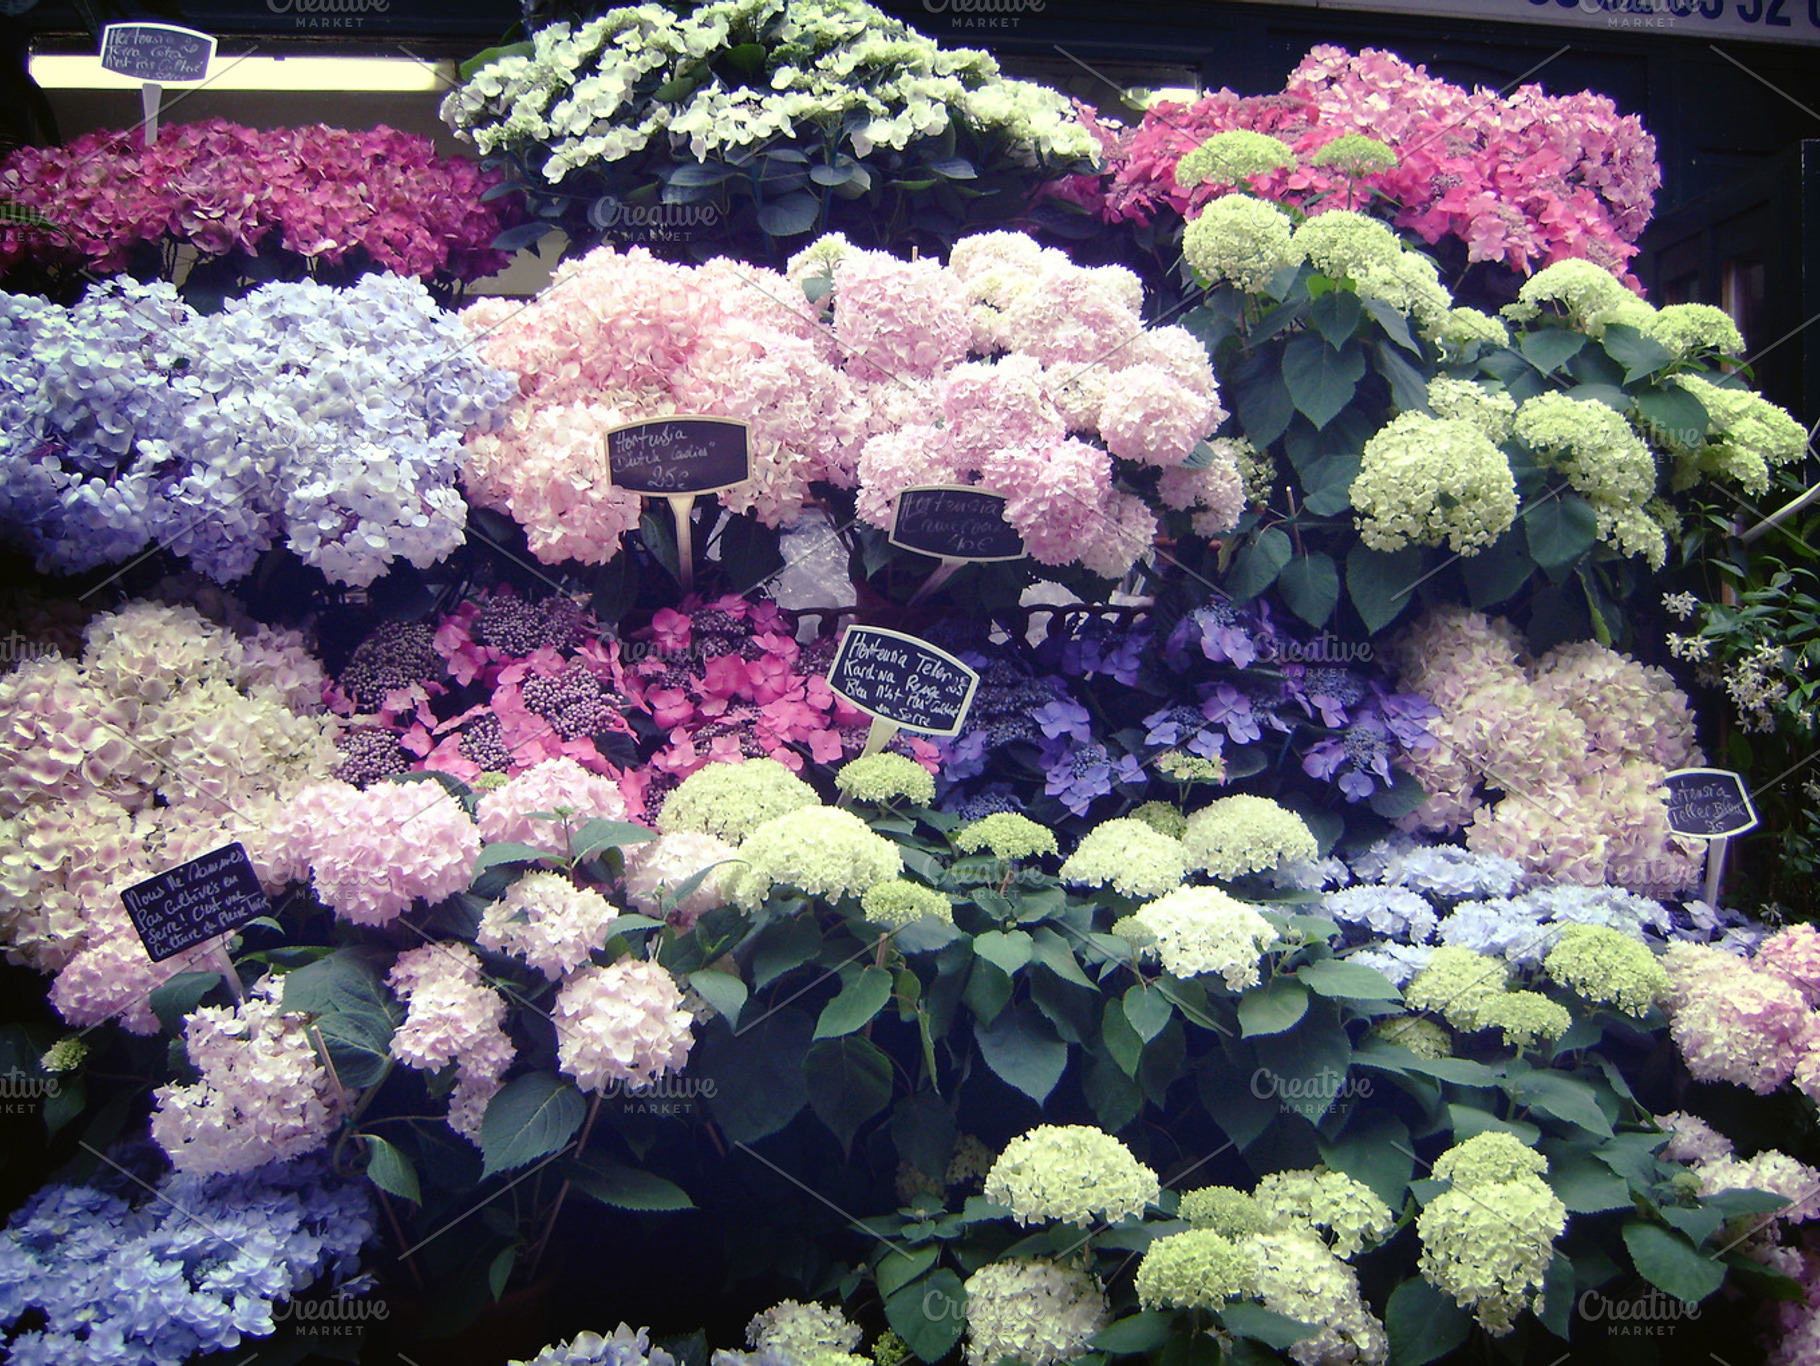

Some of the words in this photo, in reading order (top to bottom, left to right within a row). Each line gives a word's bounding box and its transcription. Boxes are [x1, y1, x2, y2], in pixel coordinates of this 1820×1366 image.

[615, 424, 688, 453] Hortensia
[848, 633, 908, 668] Hortensia
[126, 886, 165, 912] Nous
